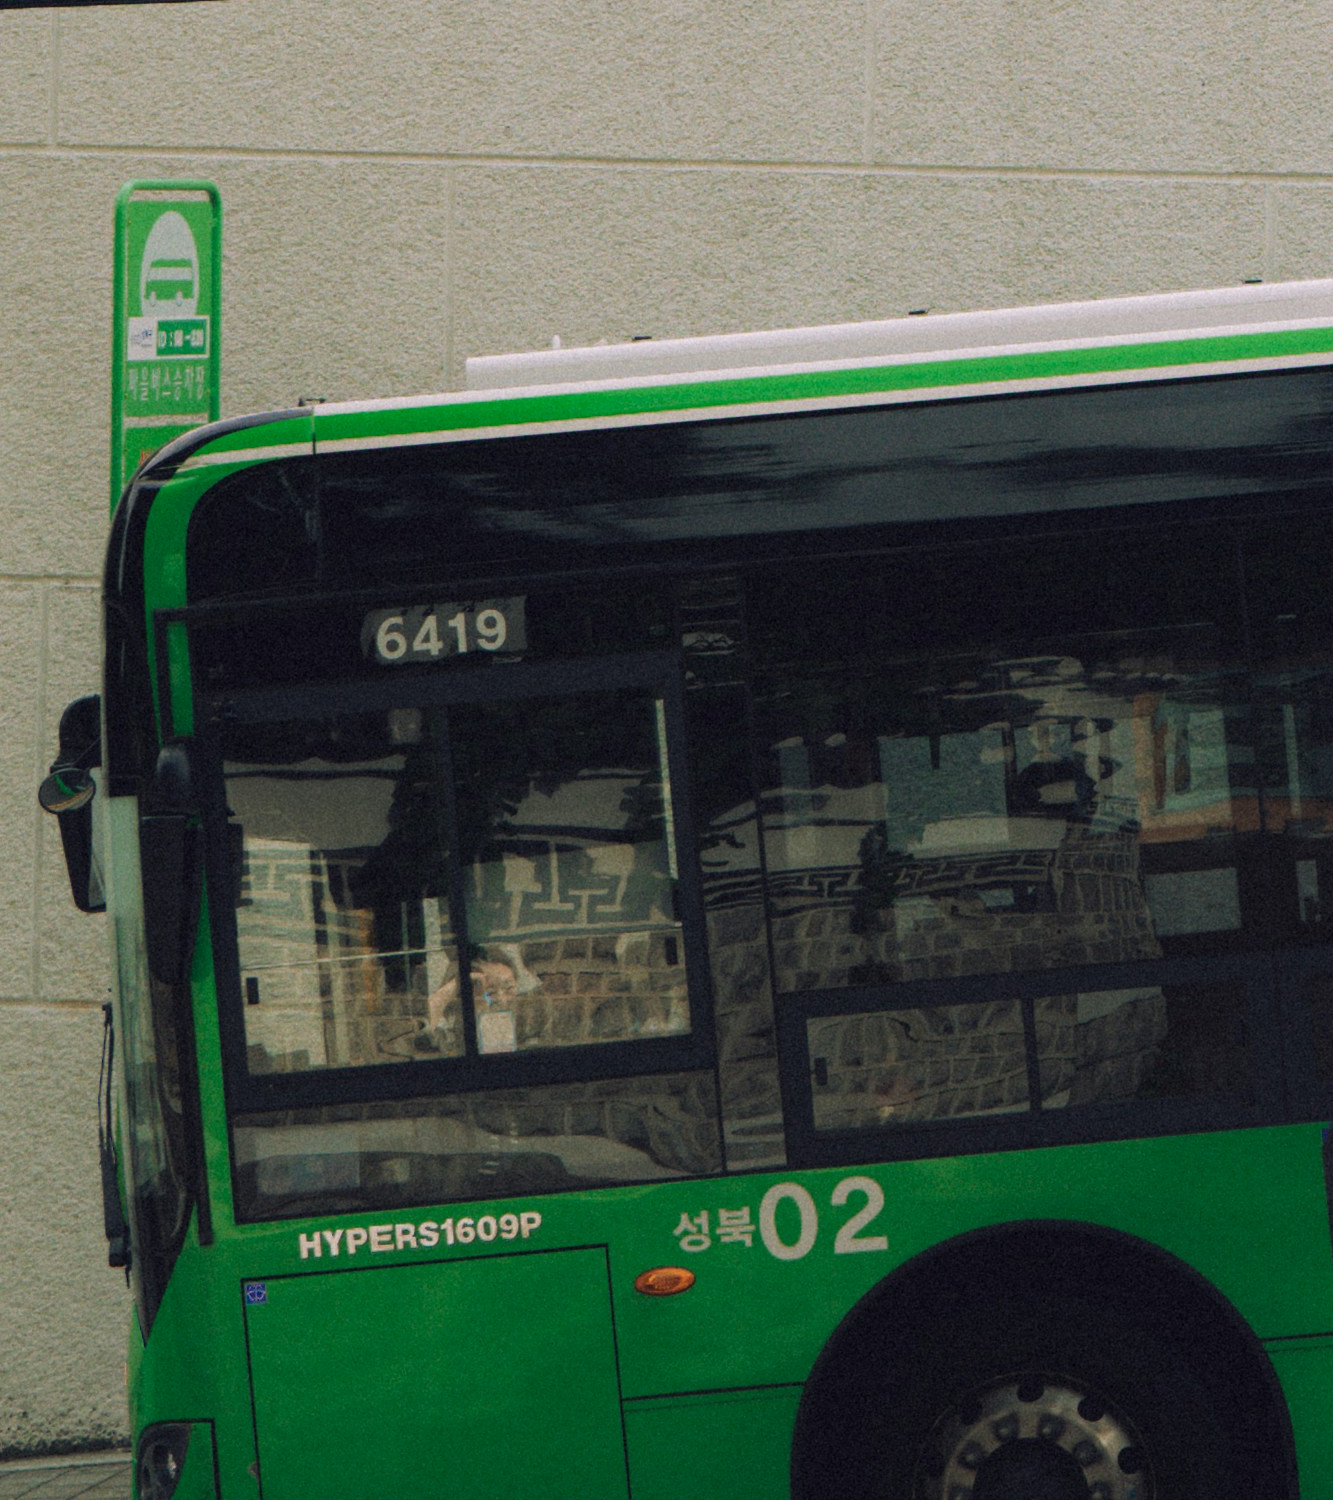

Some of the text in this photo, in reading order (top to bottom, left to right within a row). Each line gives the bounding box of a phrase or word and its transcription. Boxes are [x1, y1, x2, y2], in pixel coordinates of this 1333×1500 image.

[376, 608, 507, 661] 6419
[299, 1211, 543, 1259] HYPERS1609P
[672, 1175, 889, 1262] 성북 02
